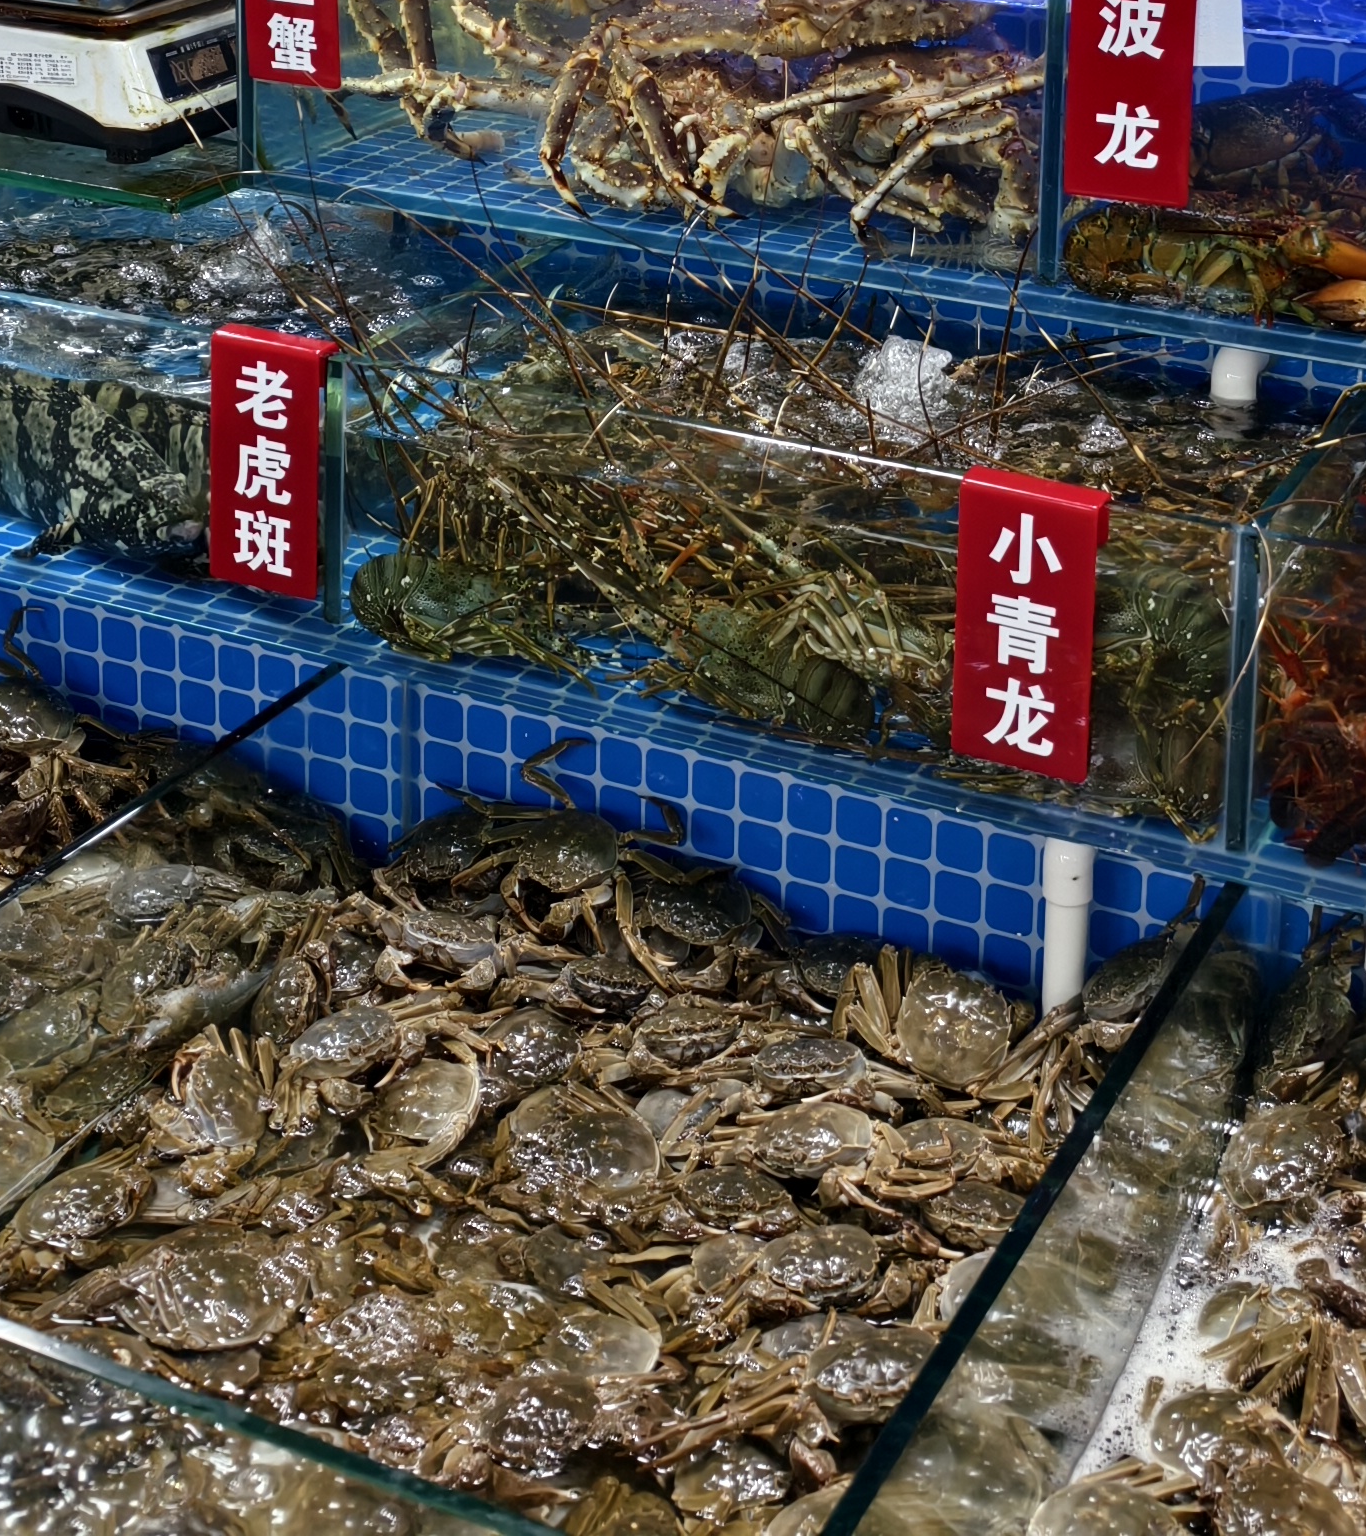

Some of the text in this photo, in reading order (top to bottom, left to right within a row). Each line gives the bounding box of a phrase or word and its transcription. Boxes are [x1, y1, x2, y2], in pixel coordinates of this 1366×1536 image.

[232, 360, 293, 577] 老虎斑
[983, 512, 1063, 757] 小青龙
